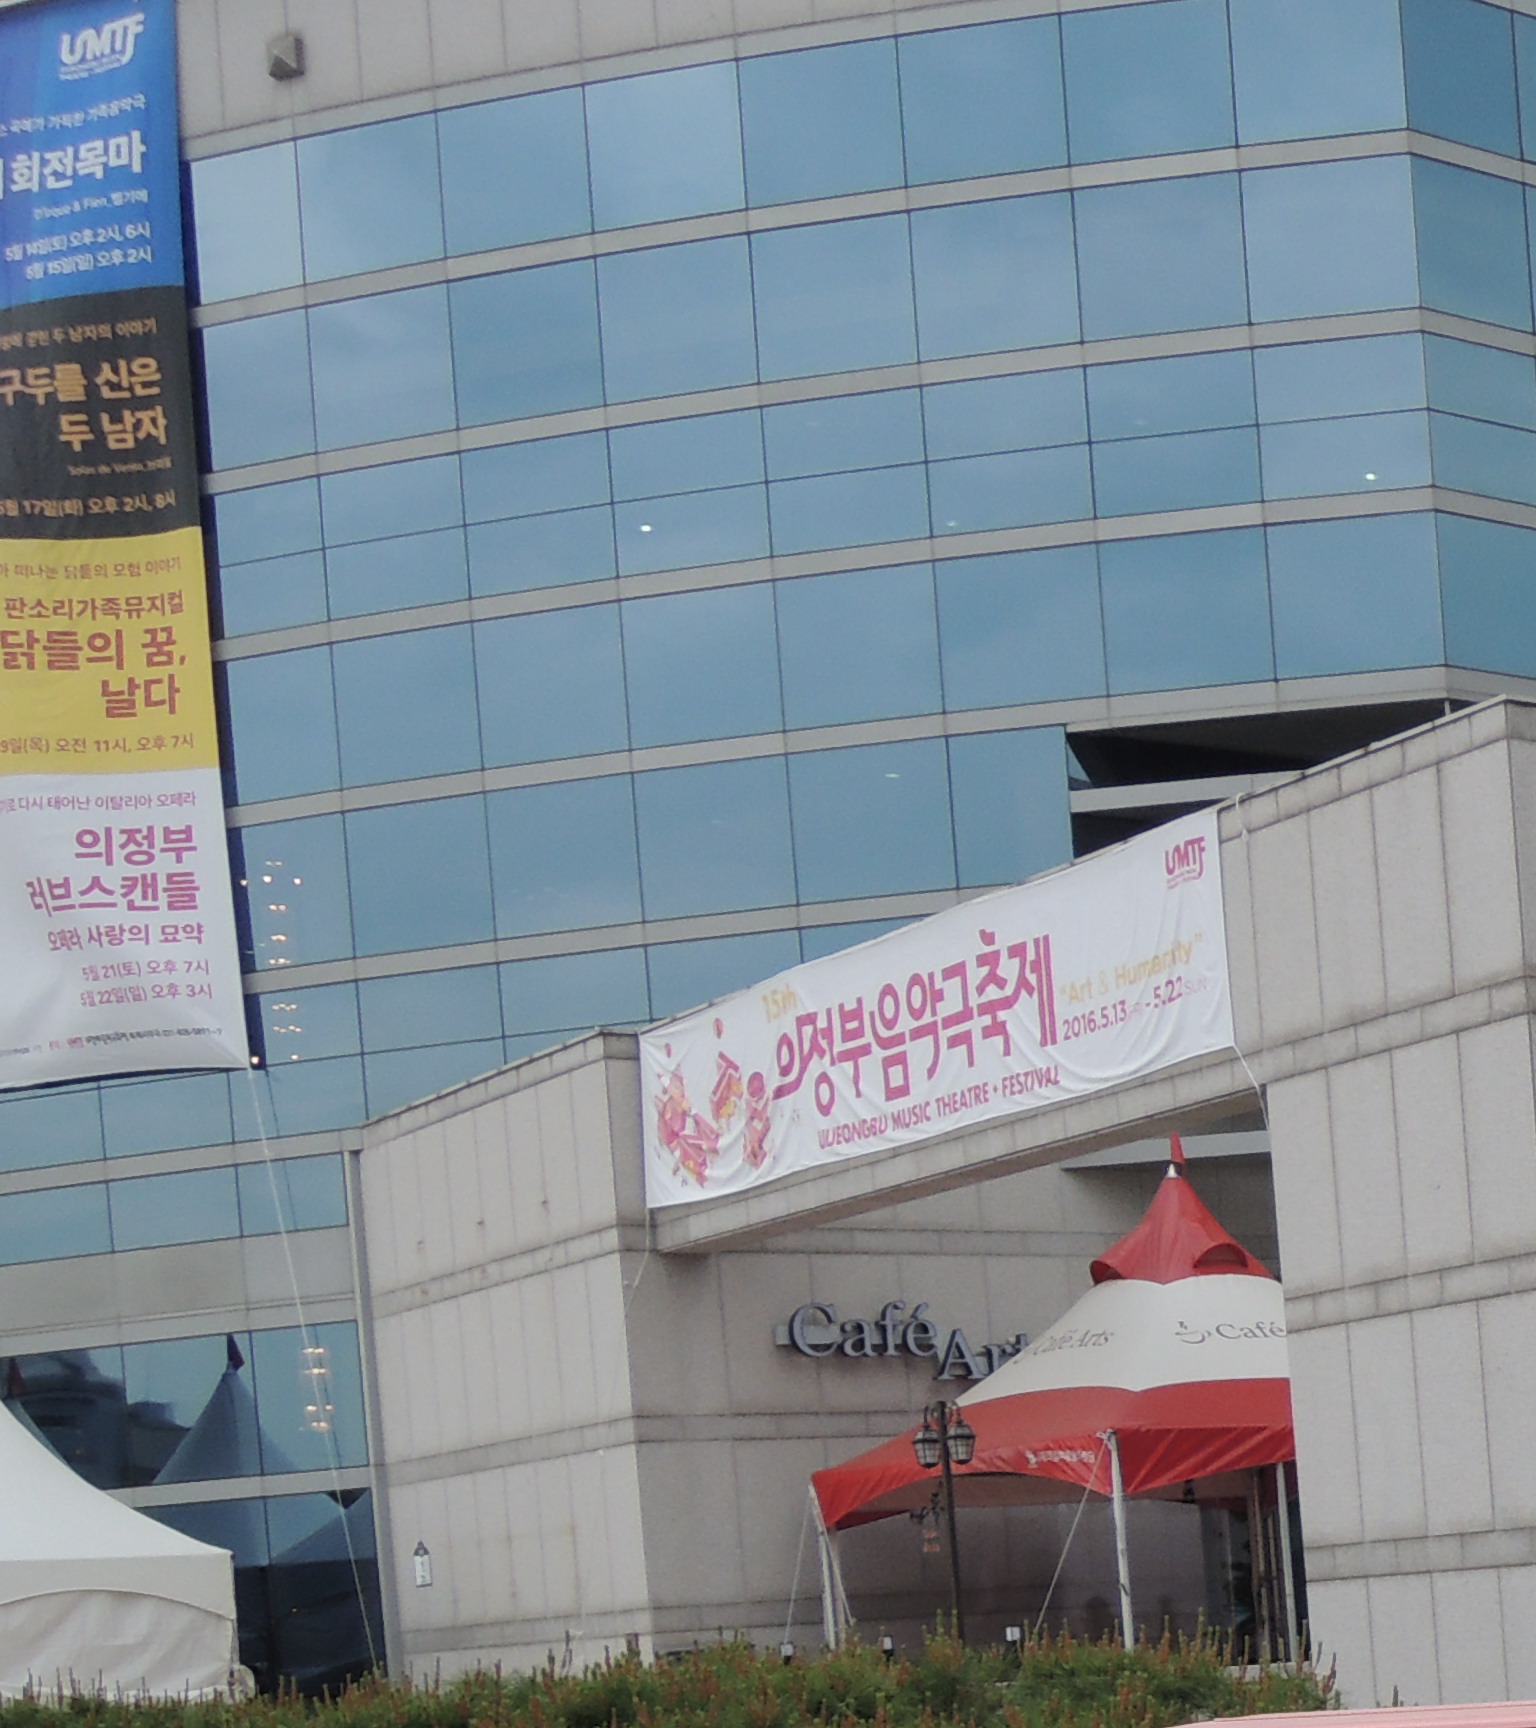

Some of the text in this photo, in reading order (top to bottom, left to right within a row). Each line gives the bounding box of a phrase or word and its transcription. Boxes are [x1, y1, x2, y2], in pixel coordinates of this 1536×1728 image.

[10, 130, 147, 192] 회전목마
[70, 228, 94, 247] 오후
[96, 248, 124, 267] 오후
[127, 245, 152, 264] 2시
[115, 317, 156, 338] 이야기
[94, 356, 162, 399] 신은
[59, 404, 168, 452] 두 남자
[88, 496, 119, 515] 오후
[113, 562, 142, 578] 모험
[145, 556, 181, 574] 이야기
[4, 589, 184, 621] 판소리가족뮤지컬
[0, 625, 187, 671] 닭들의 꿈,
[101, 673, 181, 719] 날다
[55, 737, 87, 754] 오전
[137, 734, 167, 751] 오후
[171, 731, 195, 749] 7시
[47, 795, 91, 811] 태어난
[94, 793, 153, 811] 이탈리아
[156, 790, 197, 807] 오페라
[74, 824, 198, 867] 의정부
[25, 871, 200, 918] 러브스캔들
[87, 923, 151, 948] 사랑의
[158, 922, 205, 945] 묘약
[146, 959, 178, 976] 오후
[183, 959, 210, 976] 7시
[150, 982, 182, 999] 오후
[185, 983, 213, 1000] 3시
[771, 928, 1058, 1118] 의정부음악극축제
[1062, 999, 1128, 1041] 2016.5.13
[891, 1100, 931, 1131] MUSIC
[934, 1081, 990, 1118] THEATRE
[1002, 1065, 1060, 1098] FESTIVAL
[788, 1300, 937, 1358] Café
[1215, 1321, 1287, 1340] Café
